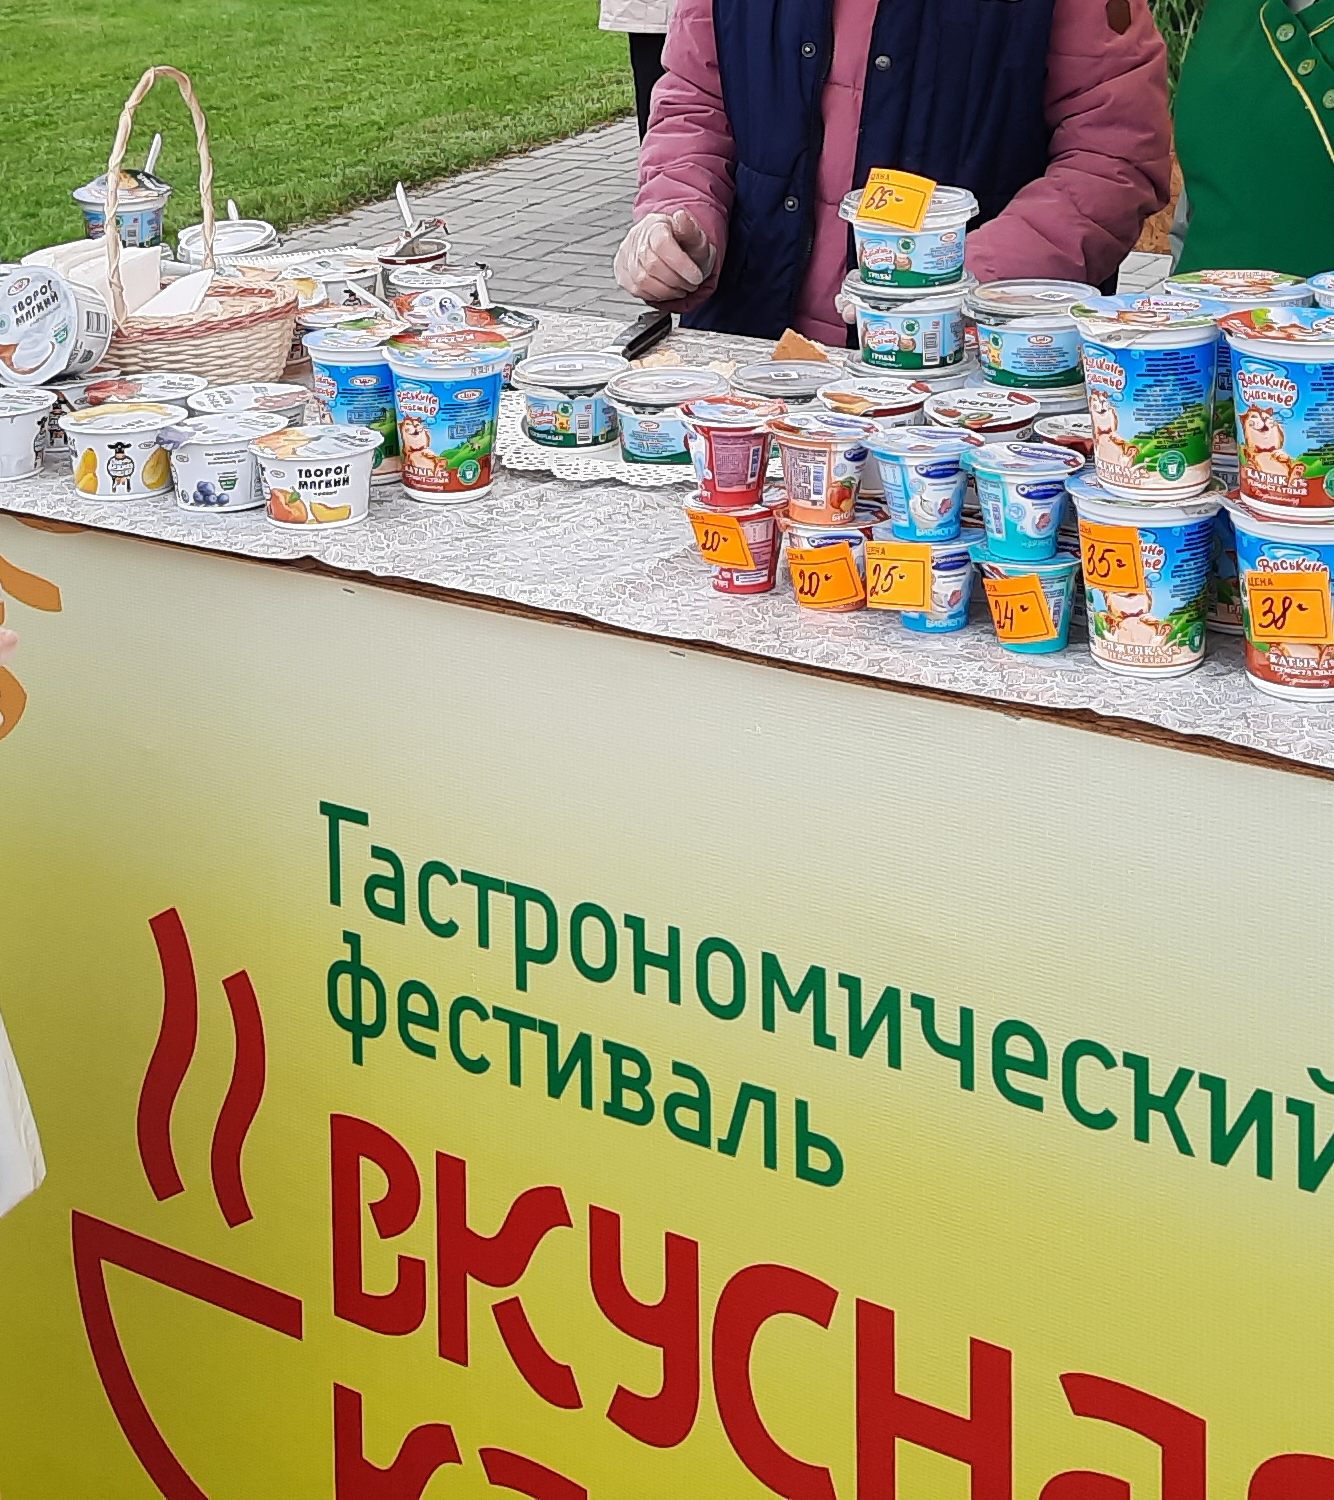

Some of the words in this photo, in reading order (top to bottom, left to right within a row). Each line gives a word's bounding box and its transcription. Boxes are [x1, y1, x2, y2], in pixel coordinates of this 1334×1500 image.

[297, 463, 351, 479] ТВОРОГ
[1248, 577, 1274, 587] ЦЕНА
[325, 931, 846, 1188] фестиваль
